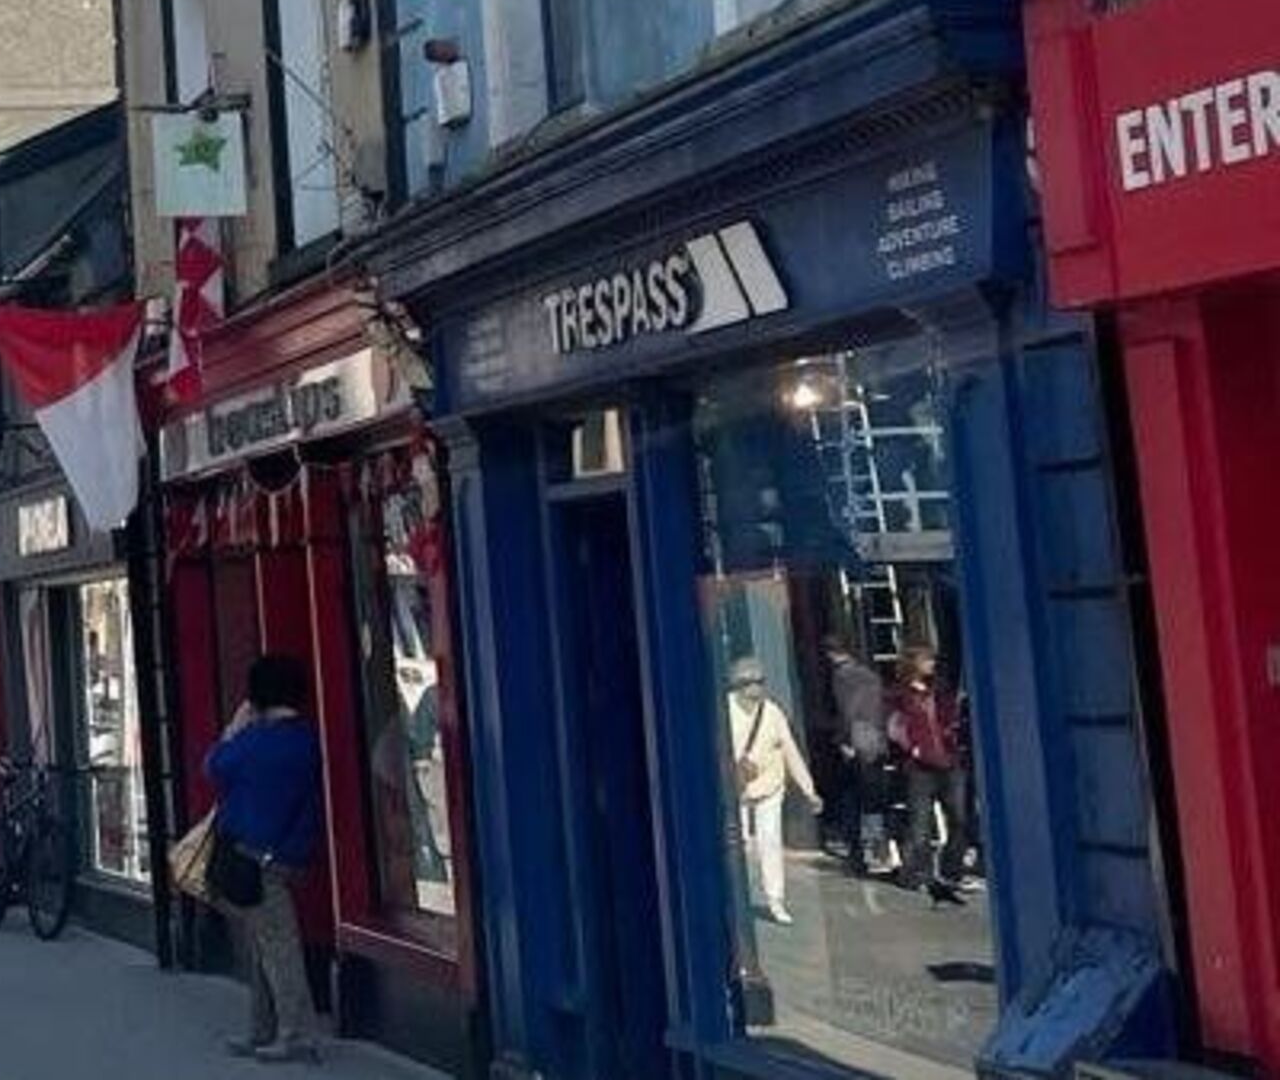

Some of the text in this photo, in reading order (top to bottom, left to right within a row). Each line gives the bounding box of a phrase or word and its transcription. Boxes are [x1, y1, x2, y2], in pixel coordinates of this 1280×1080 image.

[1116, 69, 1280, 191] ENTER
[878, 214, 960, 253] ADVENTURE
[543, 255, 688, 353] TRESPASS
